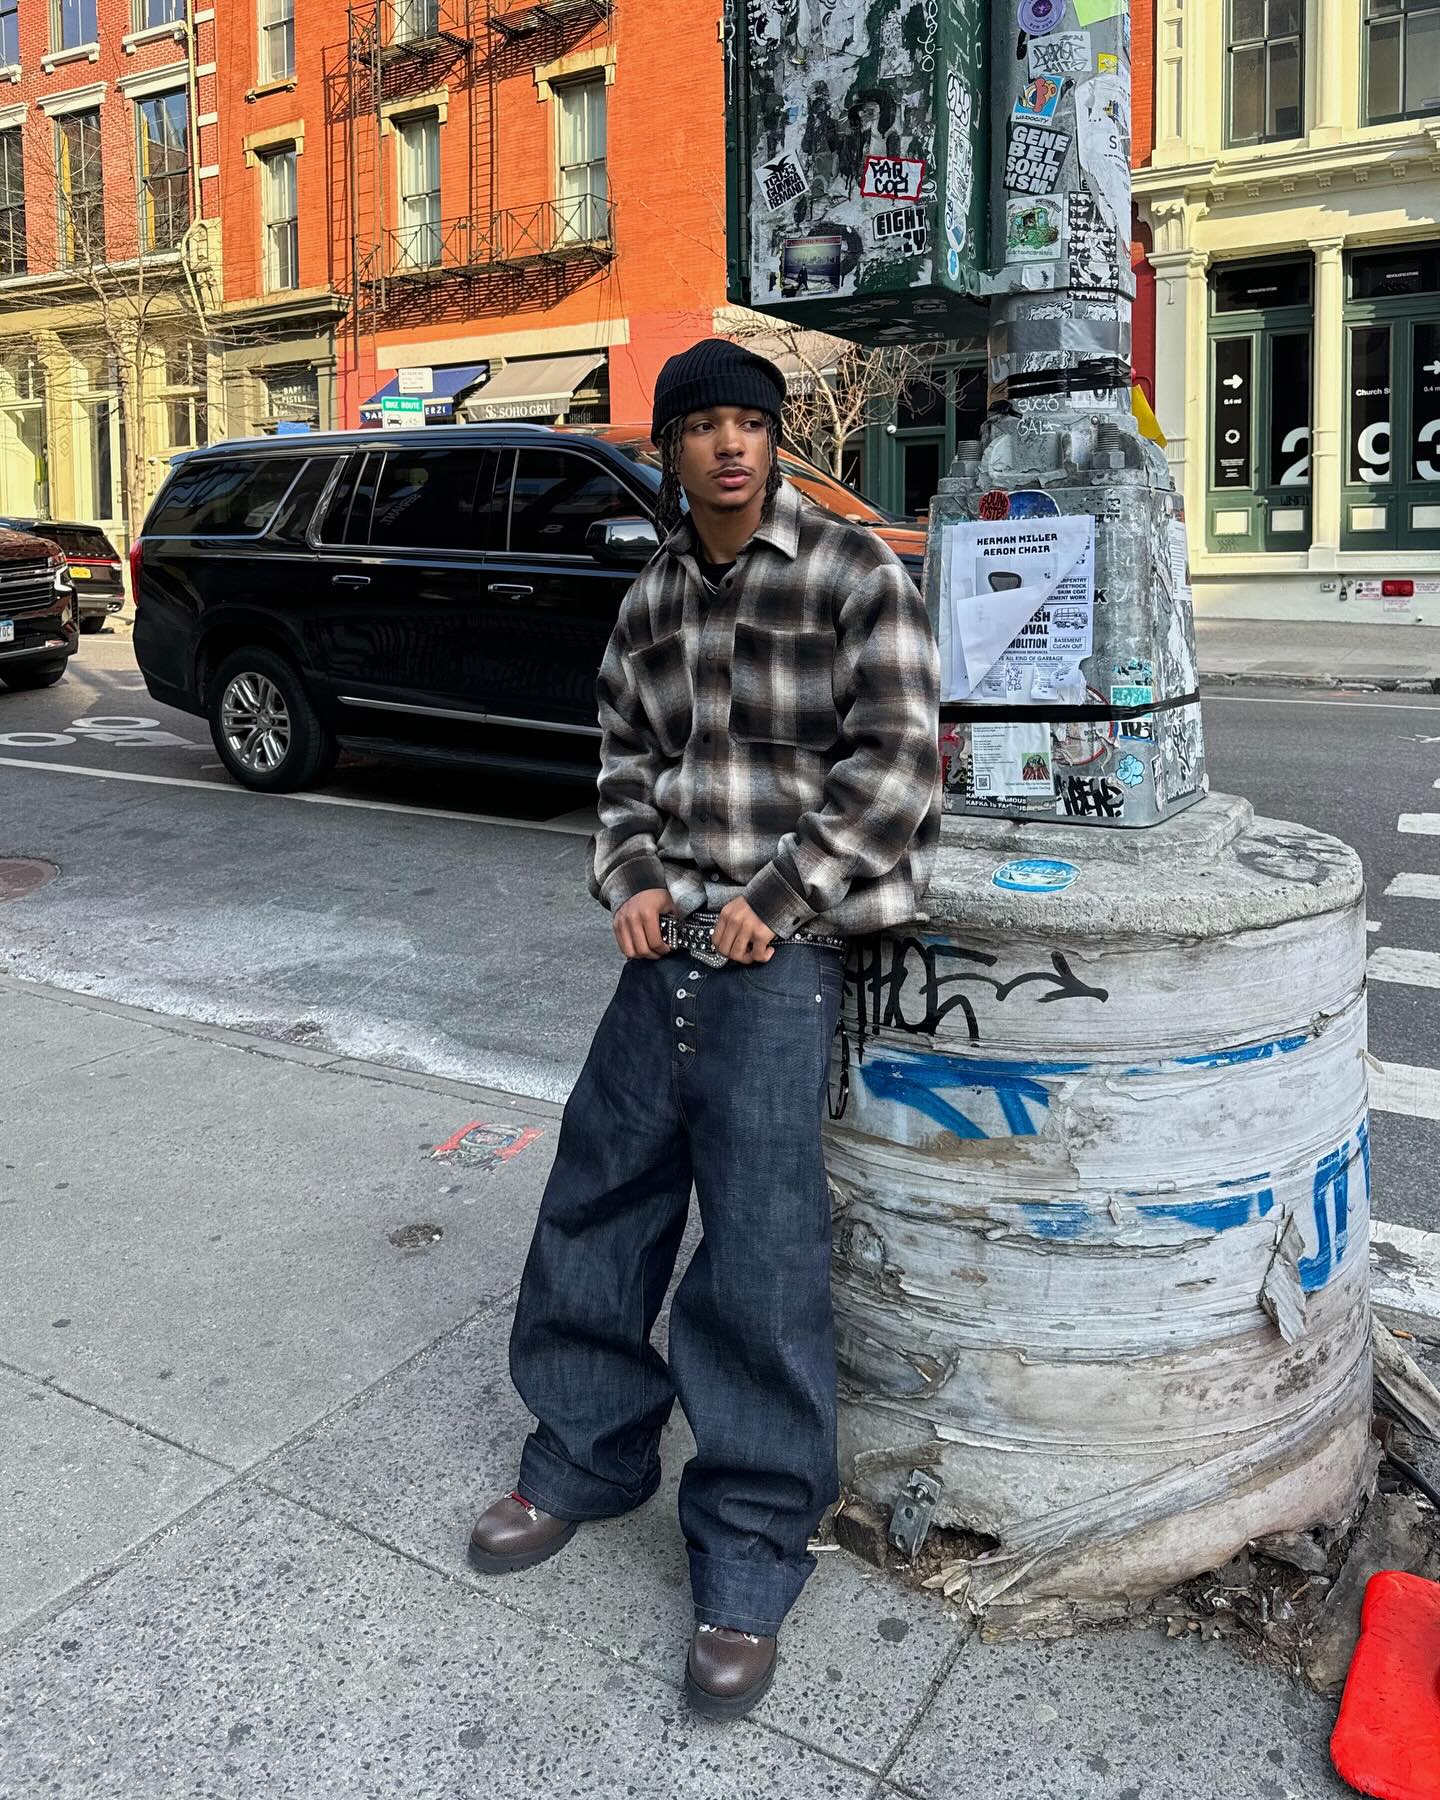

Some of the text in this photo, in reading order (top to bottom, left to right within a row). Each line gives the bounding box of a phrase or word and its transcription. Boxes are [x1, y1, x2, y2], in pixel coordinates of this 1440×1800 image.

[1012, 125, 1069, 152] GENE
[1008, 141, 1060, 166] BEL
[1006, 156, 1059, 182] SOHR
[767, 172, 801, 199] GUMBA
[768, 180, 806, 210] REMAND
[876, 207, 925, 236] EIGHT
[385, 400, 420, 410] BIKE ROUTE
[1355, 388, 1382, 397] Church
[499, 405, 528, 418] SOHO
[976, 533, 1058, 546] HERMAN MILLER
[983, 545, 1051, 557] AERON CHAIR
